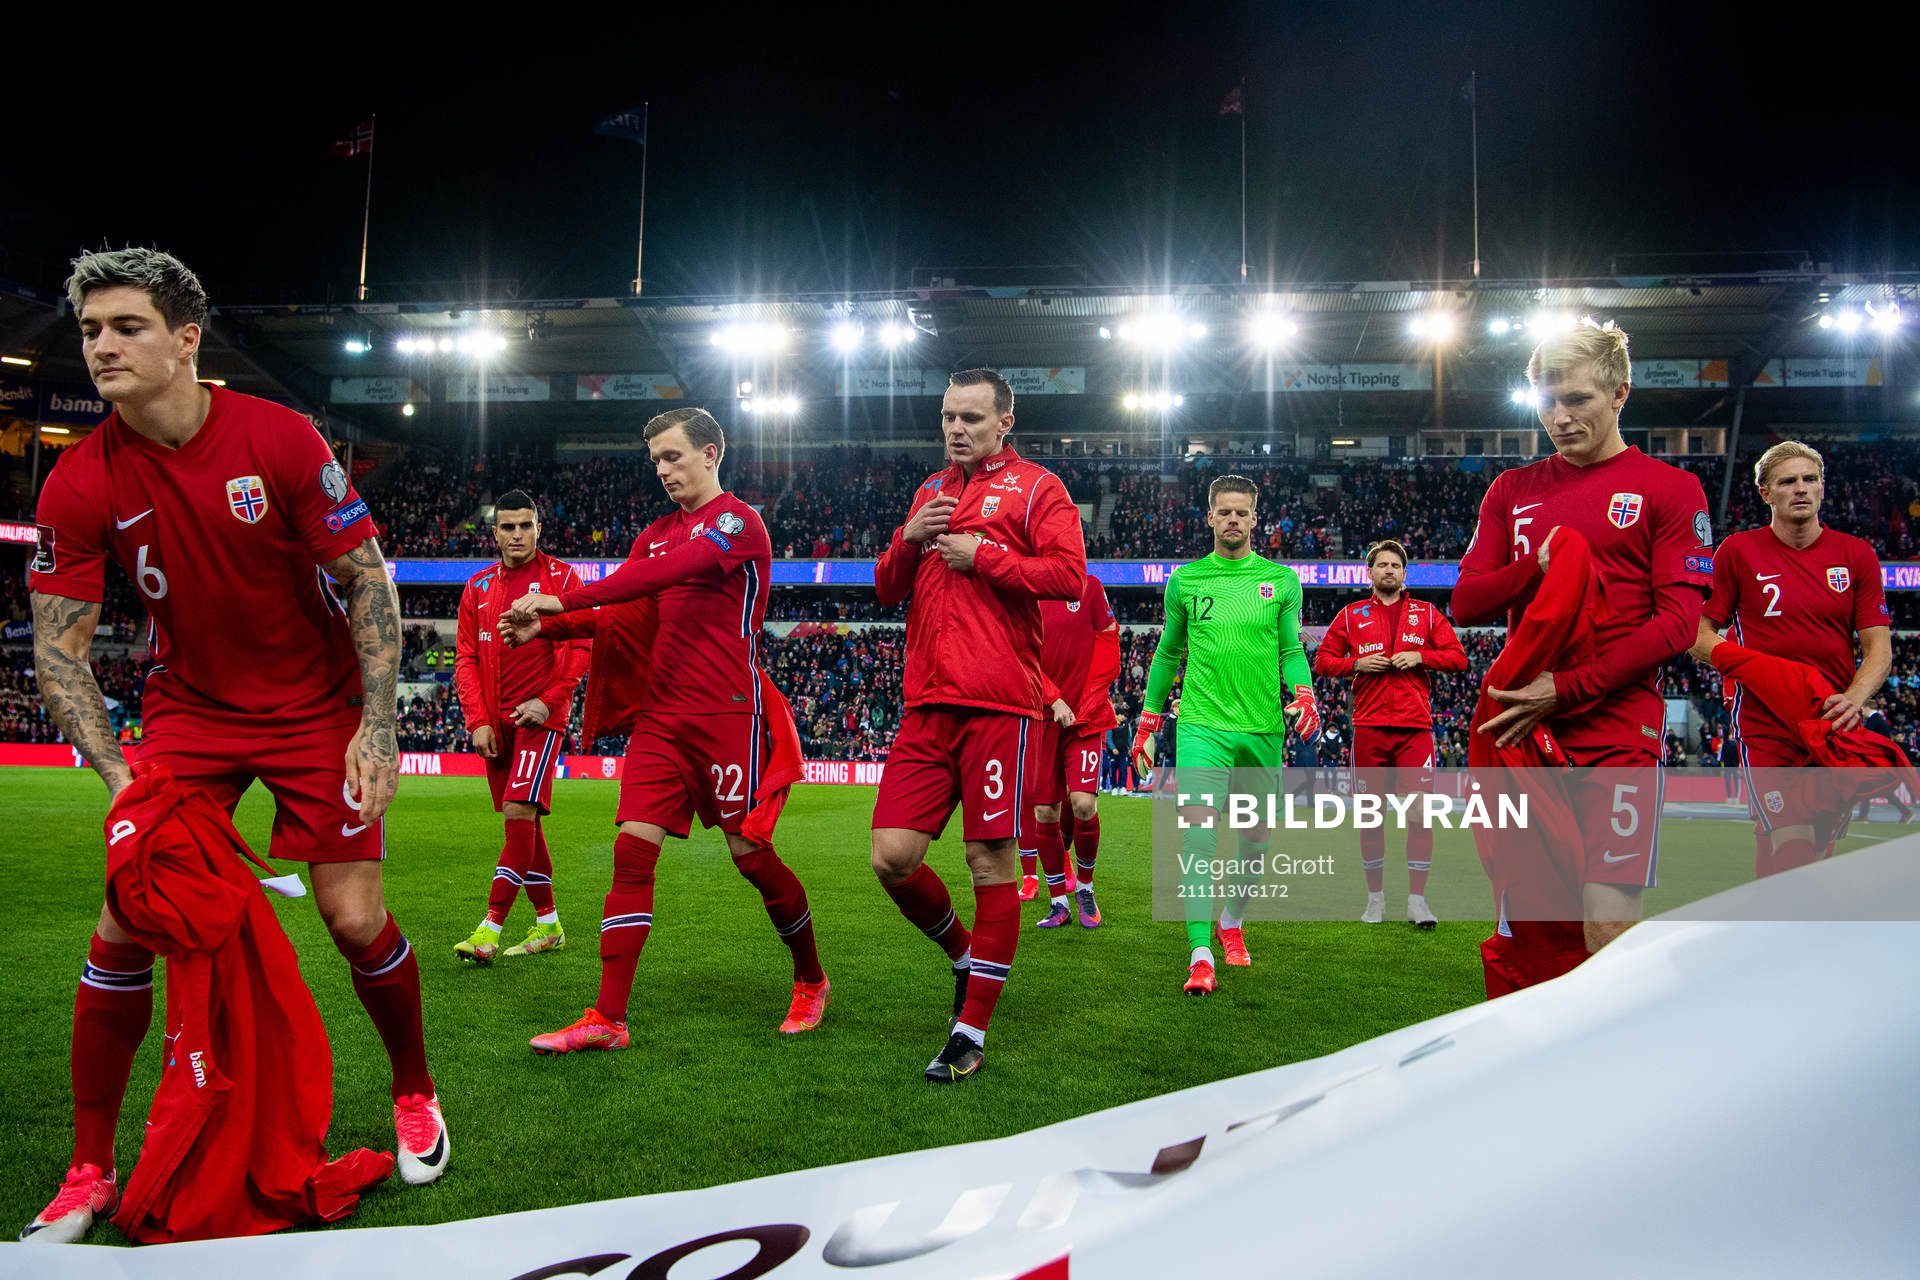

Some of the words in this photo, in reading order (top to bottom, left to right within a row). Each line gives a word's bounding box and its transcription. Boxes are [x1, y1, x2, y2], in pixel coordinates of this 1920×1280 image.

[1307, 372, 1347, 385] Norsk
[1348, 372, 1401, 388] Tipping
[50, 394, 105, 413] bama
[341, 501, 369, 522] RESPECT
[708, 530, 731, 551] RESPECT
[136, 544, 168, 600] 6
[1328, 564, 1371, 584] LATVI
[1191, 596, 1214, 622] 12
[1762, 583, 1782, 617] 2
[5, 621, 34, 639] Bend
[1402, 632, 1425, 646] bama
[1358, 642, 1384, 654] bama
[516, 750, 537, 779] 11
[1080, 749, 1099, 772] 19
[1422, 752, 1434, 773] 4
[710, 763, 745, 801] 22
[983, 759, 1004, 800] 3
[1610, 784, 1639, 837] 5
[189, 1051, 208, 1089] bama
